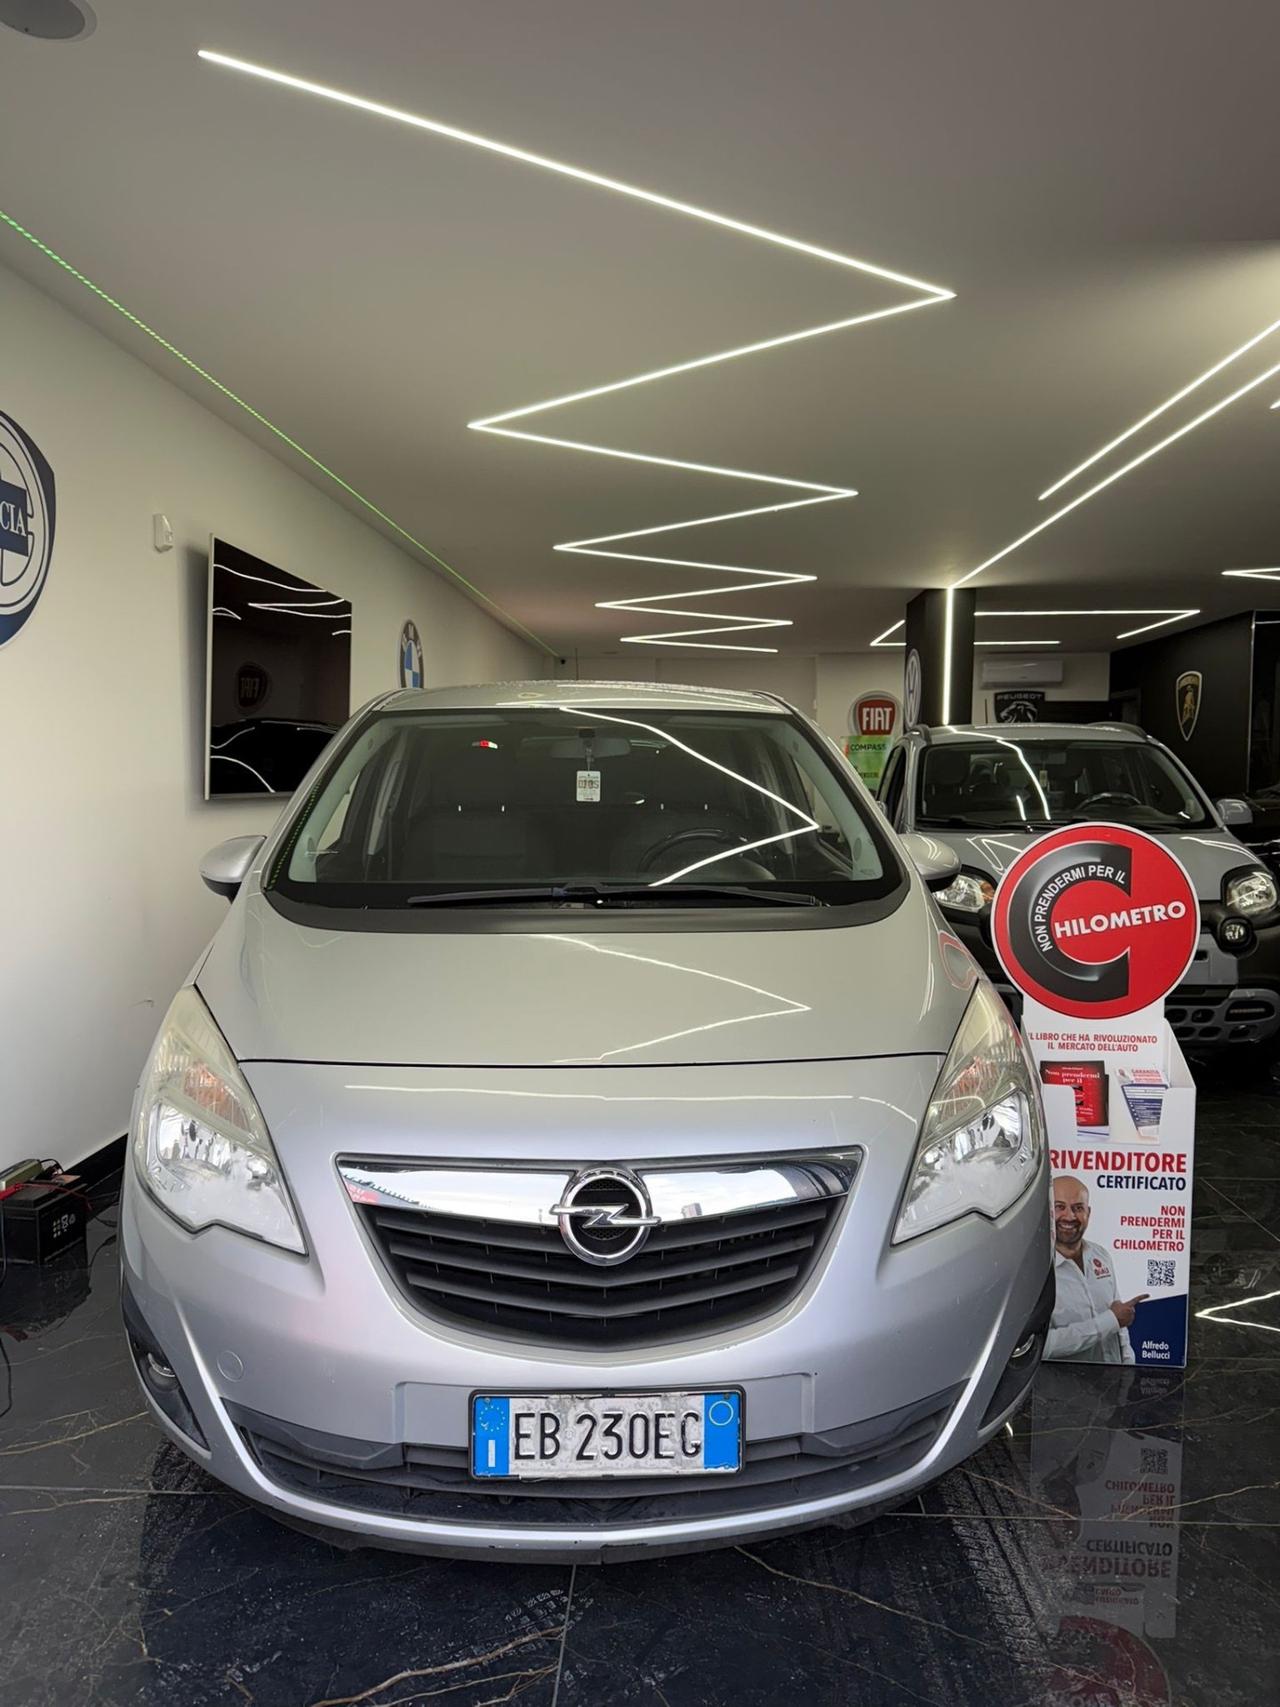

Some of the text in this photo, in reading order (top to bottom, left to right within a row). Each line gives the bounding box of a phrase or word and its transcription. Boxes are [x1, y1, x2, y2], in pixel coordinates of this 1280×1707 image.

[862, 706, 892, 731] FIAT
[1034, 864, 1126, 952] NON PRENDERMI PER IL
[1028, 1033, 1158, 1044] L LIBRO CHE HA RIVOLUZIONATO
[1047, 1042, 1138, 1052] IL MERCATO DELL'AUTO
[1049, 1150, 1187, 1173] RIVENDITORE
[1096, 1174, 1186, 1191] CERTIFICATO
[1160, 1206, 1186, 1216] NON
[1120, 1216, 1185, 1228] PRENDERMI
[1152, 1229, 1185, 1240] PER IL
[1113, 1239, 1184, 1252] CHILOMETRO
[1142, 1341, 1169, 1350] Alfredo
[1142, 1350, 1170, 1360] Bellucci
[514, 1412, 560, 1460] EB
